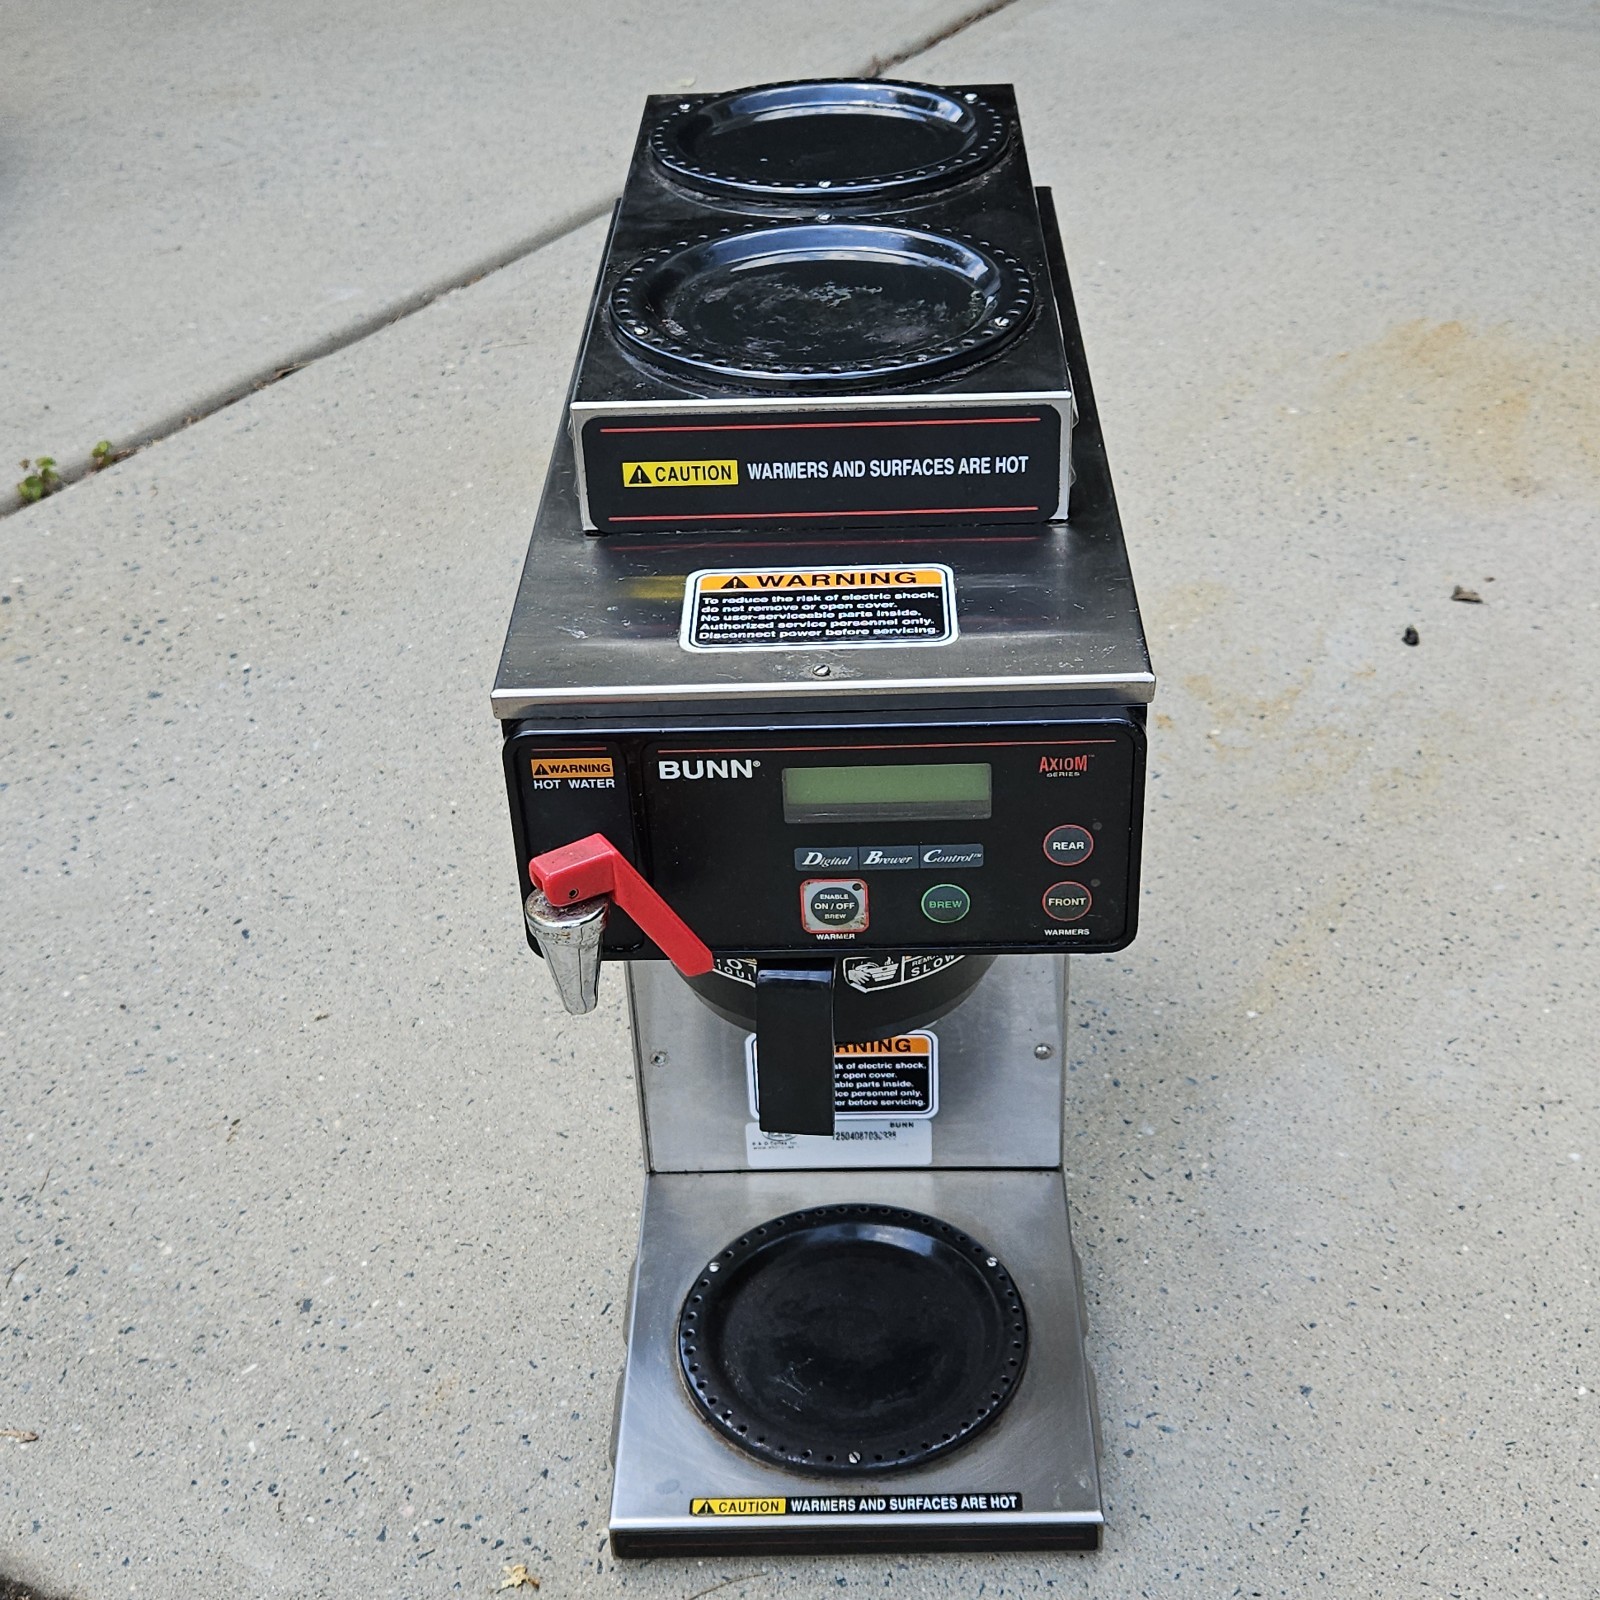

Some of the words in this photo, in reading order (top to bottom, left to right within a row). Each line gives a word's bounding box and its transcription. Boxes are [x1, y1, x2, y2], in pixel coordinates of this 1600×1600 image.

[655, 464, 732, 482] CAUTION
[747, 461, 829, 480] WARMERS
[832, 460, 866, 478] AND
[869, 458, 955, 477] SURFACES
[958, 457, 991, 474] ARE
[995, 456, 1029, 474] HOT
[756, 571, 917, 588] WARNING
[702, 597, 719, 605] To
[722, 596, 769, 604] reduce
[771, 595, 794, 603] the
[796, 594, 823, 602] risk
[824, 594, 839, 602] of
[841, 592, 892, 601] electric
[701, 605, 719, 614] do
[722, 604, 745, 613] not
[748, 604, 799, 612] remove
[819, 602, 854, 611] open
[700, 613, 720, 622] No
[723, 610, 835, 621] user-serviceable
[838, 610, 873, 619] parts
[876, 609, 922, 617] inside.
[699, 621, 775, 631] Authorized
[777, 619, 827, 628] service
[830, 618, 898, 628] personnel
[699, 630, 776, 640] Disconnect
[779, 629, 823, 638] power
[825, 628, 870, 636] before
[549, 763, 611, 774] WARNING
[1039, 754, 1088, 773] AXIOM
[533, 780, 561, 789] HOT
[567, 778, 615, 789] WATER
[1052, 841, 1085, 850] REAR
[802, 851, 851, 867] Digital
[863, 850, 912, 866] Brewer
[814, 902, 829, 910] ON
[836, 901, 855, 910] OFF
[929, 900, 962, 909] BREW
[1048, 897, 1087, 906] FRONT
[816, 932, 855, 940] WARMER
[1044, 928, 1090, 936] WARMERS
[842, 1072, 867, 1080] open
[856, 1080, 881, 1089] parts
[882, 1080, 914, 1088] inside.
[851, 1089, 898, 1098] personnel
[848, 1098, 878, 1106] before
[718, 1500, 779, 1513] CAUTION
[790, 1498, 855, 1512] WARMERS
[858, 1498, 886, 1511] AND
[889, 1496, 957, 1511] SURFACES
[961, 1496, 987, 1509] ARE
[990, 1495, 1018, 1508] HOT
